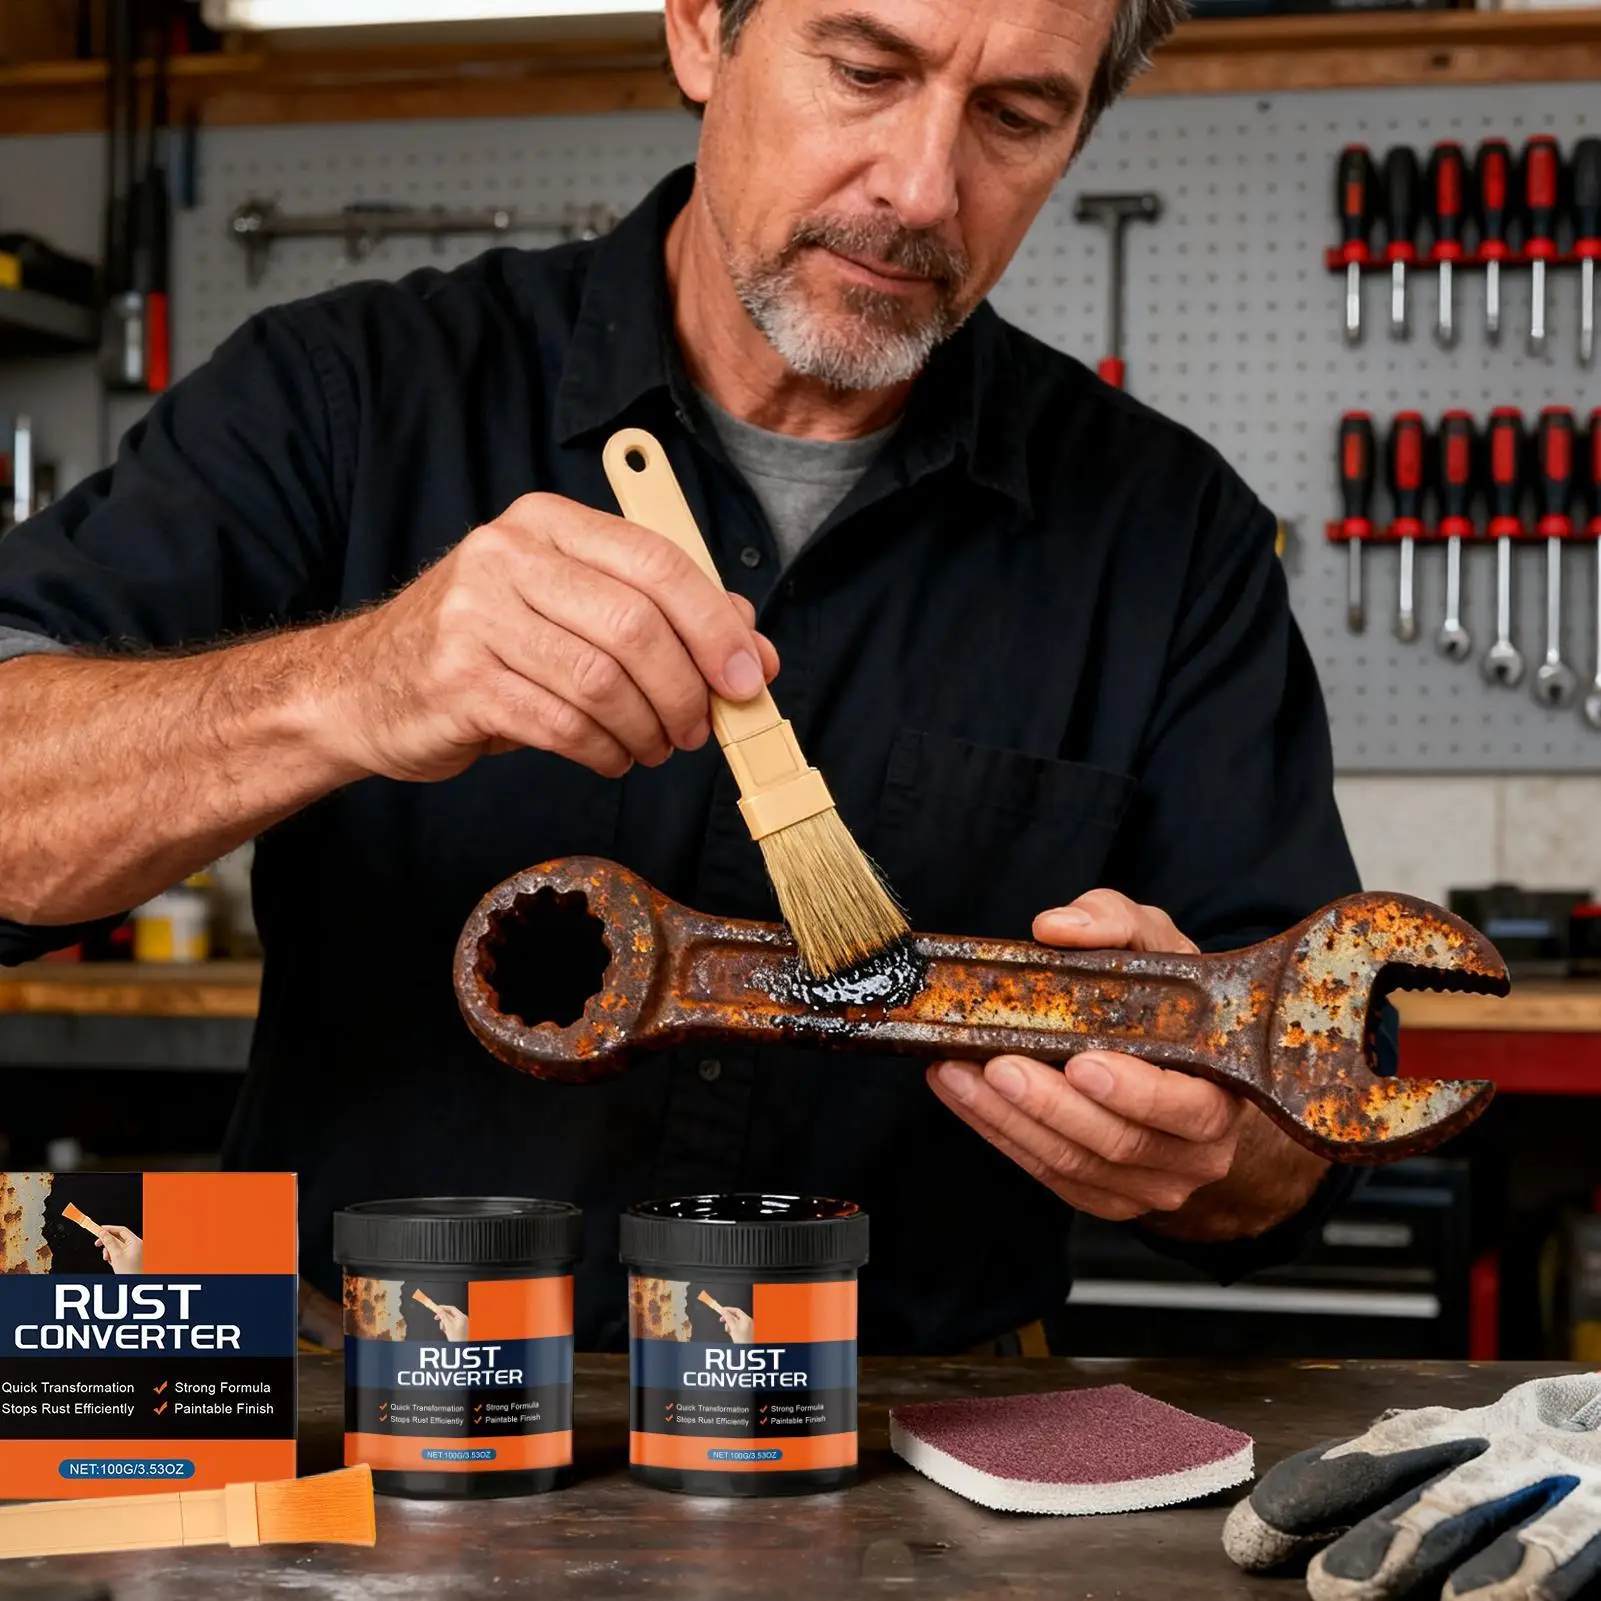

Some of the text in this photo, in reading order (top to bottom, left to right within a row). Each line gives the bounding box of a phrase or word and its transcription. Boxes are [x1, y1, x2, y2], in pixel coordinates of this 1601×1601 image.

[55, 1284, 202, 1320] RUST
[14, 1324, 241, 1350] CONVERTER
[420, 1346, 501, 1369] RUST
[705, 1348, 786, 1370] RUST
[397, 1369, 523, 1386] CONVERTER
[683, 1371, 808, 1388] CONVERTER
[1, 1382, 135, 1395] Quick Transformation
[174, 1382, 271, 1396] Strong Formula
[1, 1403, 135, 1417] Stops Rust Efficiently
[174, 1403, 274, 1415] Paintable Finish
[390, 1403, 464, 1412] Quick Transformation
[486, 1401, 539, 1412] Strong Formula
[676, 1403, 749, 1413] Quick Transformation
[771, 1404, 824, 1414] Strong Formula
[390, 1415, 464, 1426] Stops Rust Efficiently
[485, 1414, 541, 1424] Paintable Finish
[676, 1416, 749, 1427] Stops Rust Efficiently
[770, 1415, 826, 1425] Paintable Finish
[69, 1463, 184, 1476] NET:100G/3.53OZ
